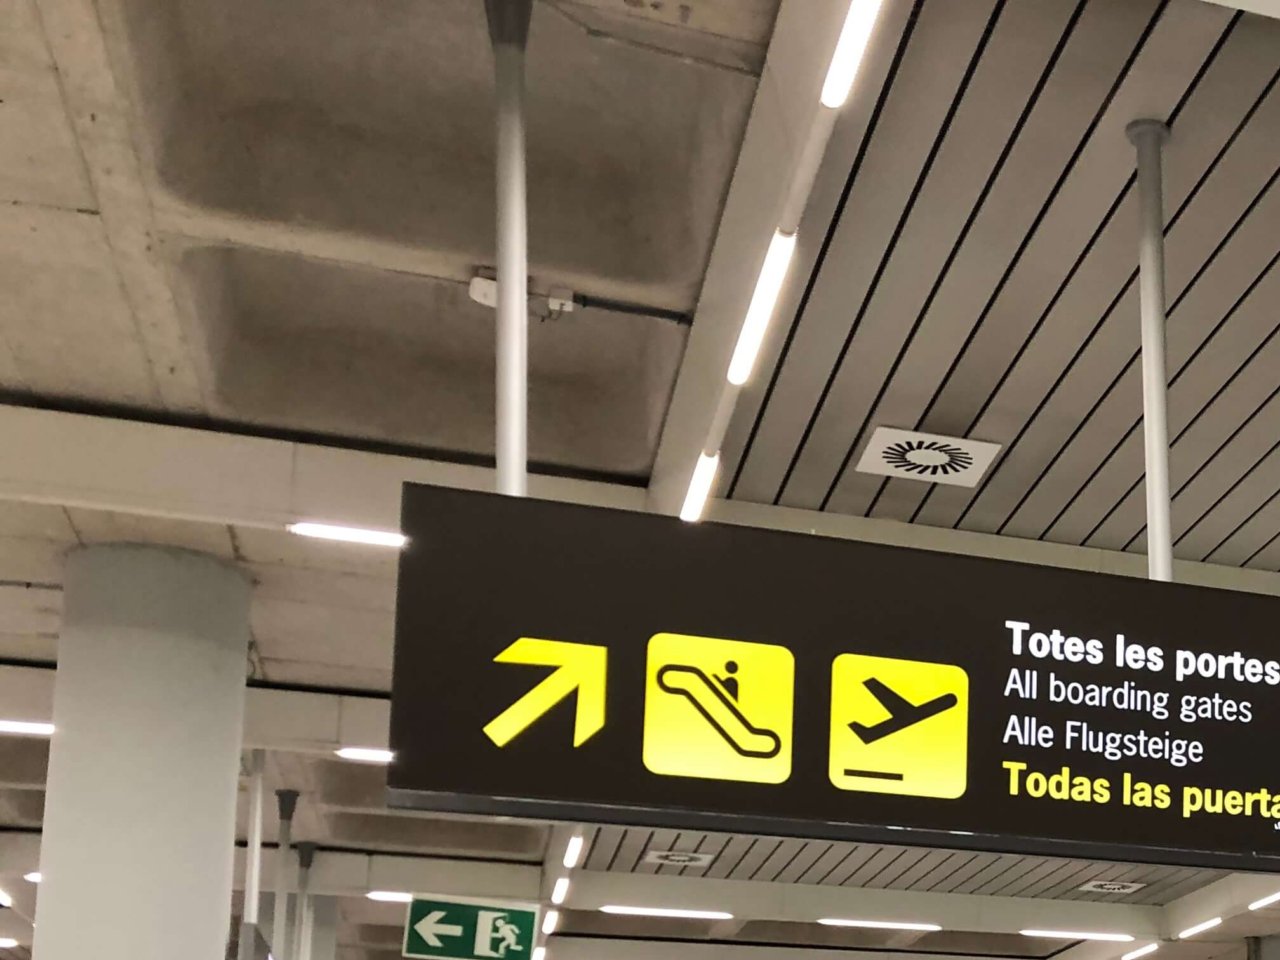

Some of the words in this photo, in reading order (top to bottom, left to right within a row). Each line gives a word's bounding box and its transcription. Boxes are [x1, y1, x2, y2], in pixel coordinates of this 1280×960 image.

[1004, 620, 1104, 665] Totes
[1115, 633, 1165, 672] les
[1175, 649, 1280, 686] portes
[1003, 667, 1038, 700] All
[1049, 672, 1170, 720] boarding
[1179, 692, 1253, 723] gates
[1002, 714, 1055, 748] Alle
[1065, 720, 1204, 768] Flugsteige
[1002, 760, 1111, 804] Todas
[1122, 772, 1171, 809] las
